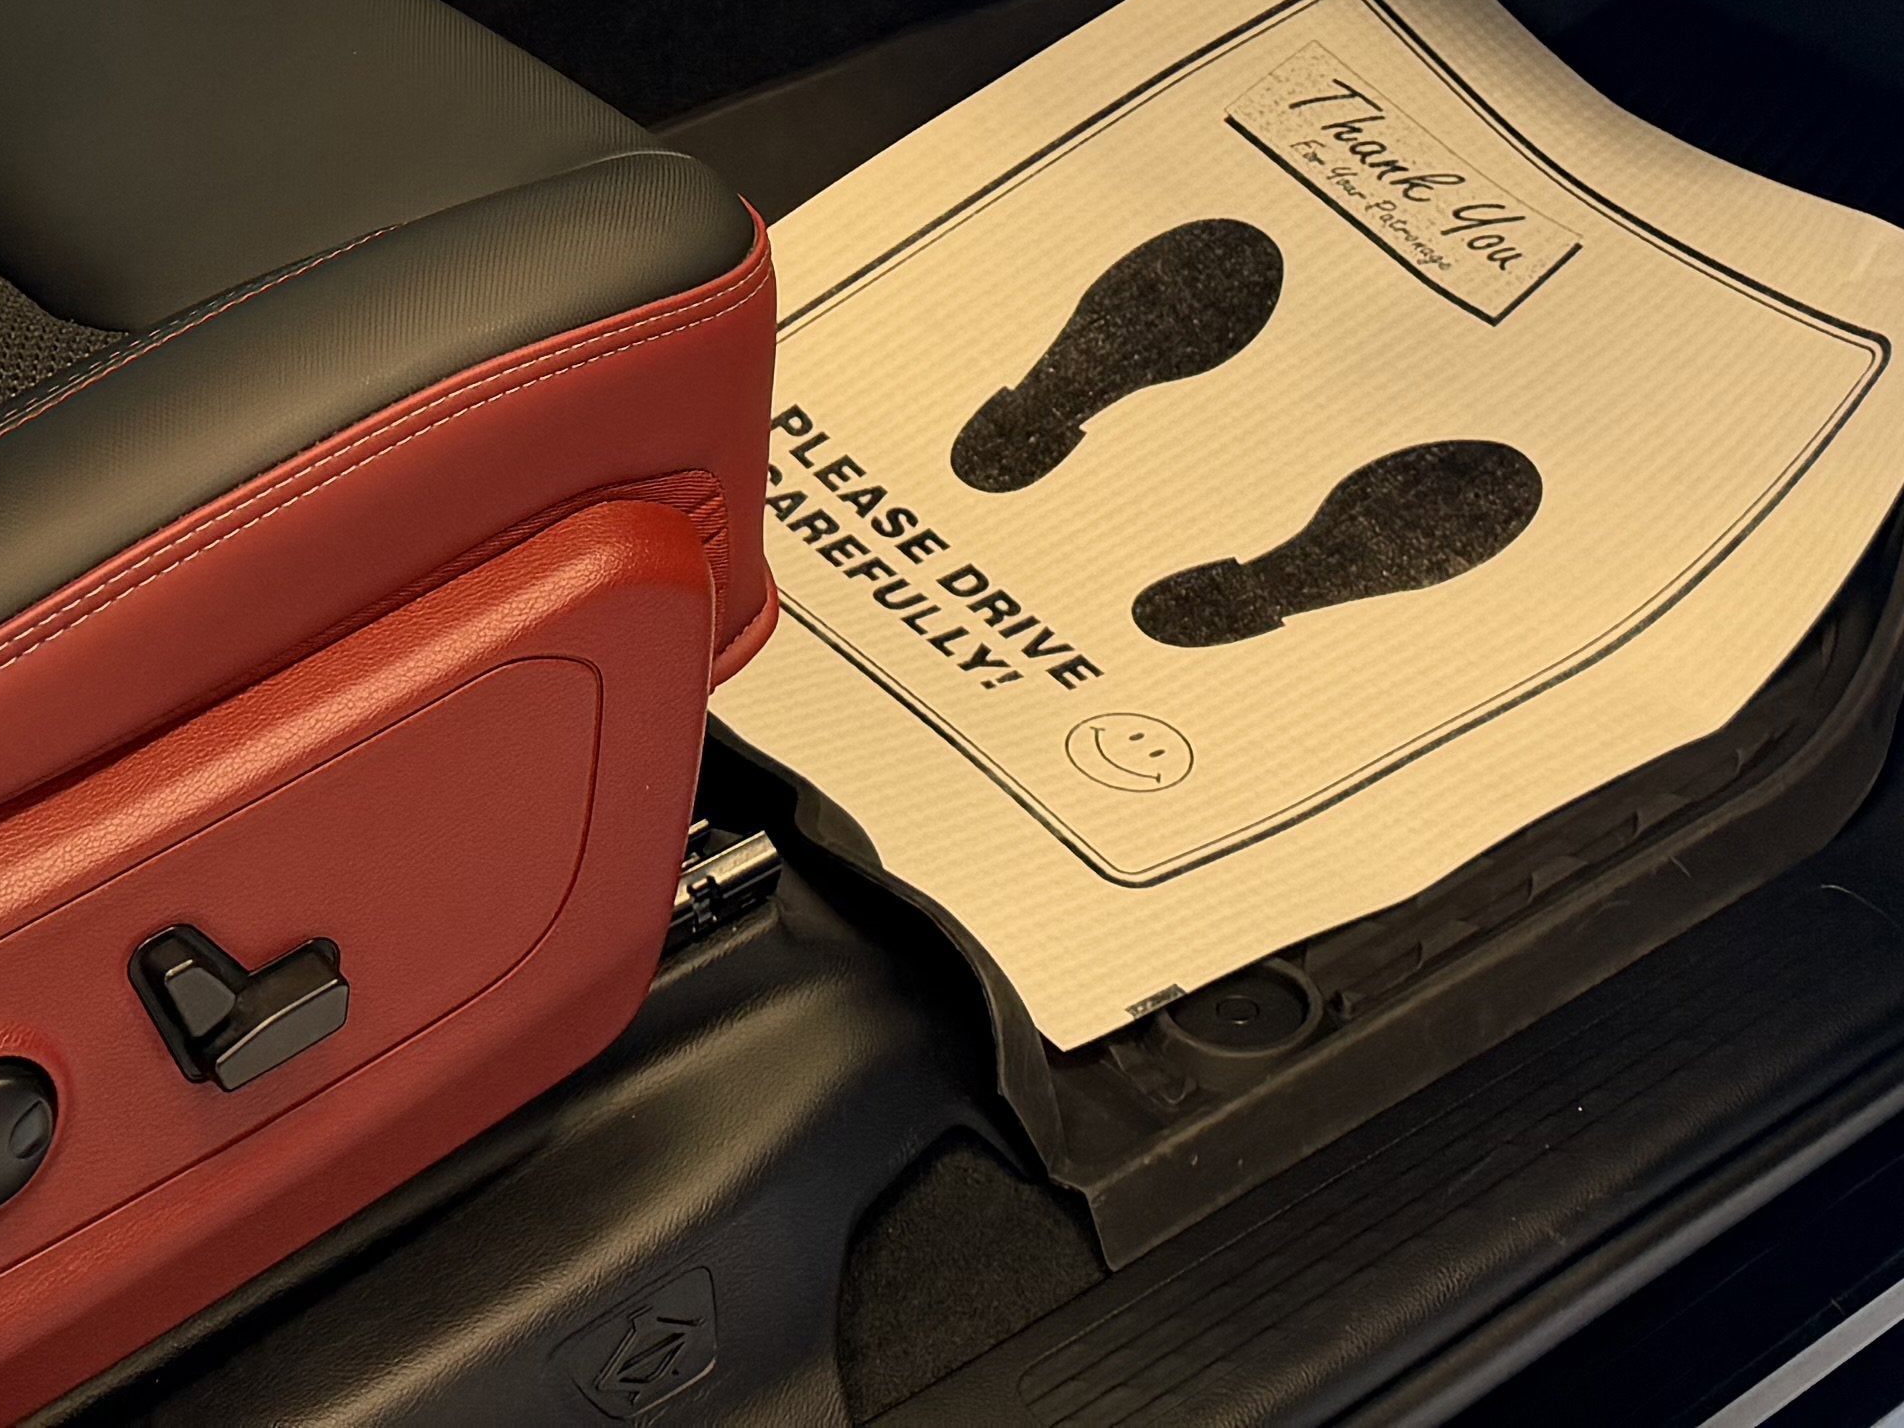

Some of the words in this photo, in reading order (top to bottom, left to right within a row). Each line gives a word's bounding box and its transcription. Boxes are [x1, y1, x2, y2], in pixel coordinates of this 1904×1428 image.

[1288, 78, 1466, 203] Thank
[1440, 203, 1526, 271] You
[1290, 139, 1325, 167] For
[1326, 166, 1366, 200] Your
[1364, 200, 1452, 272] Patronage
[770, 403, 952, 566] PLEASE
[936, 562, 1106, 691] DRIVE
